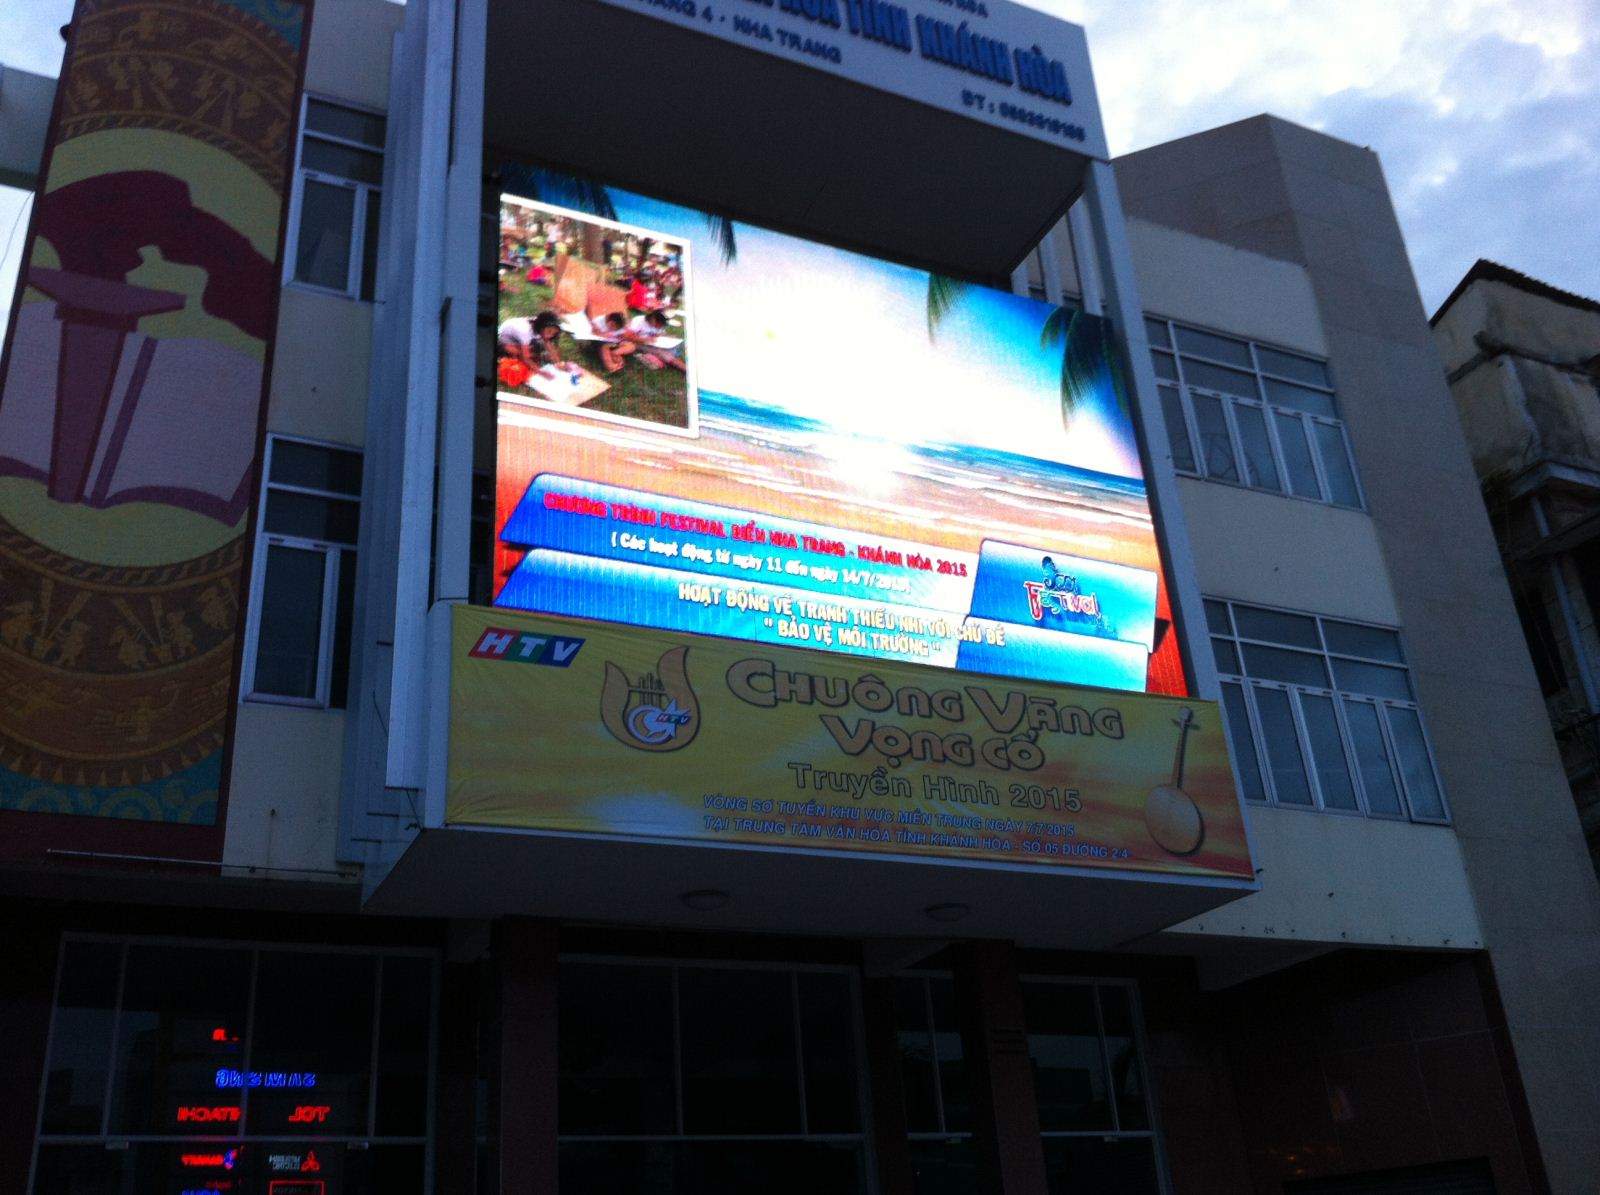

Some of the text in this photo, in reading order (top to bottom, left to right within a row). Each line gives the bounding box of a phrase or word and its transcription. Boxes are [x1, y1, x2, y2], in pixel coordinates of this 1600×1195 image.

[733, 14, 774, 42] NHA
[776, 28, 842, 64] TRANG
[660, 511, 726, 538] FESTIVAL
[769, 529, 798, 549] NHA
[802, 535, 846, 558] TRANG
[858, 545, 903, 567] KHÁNH
[906, 551, 933, 572] HÒA
[936, 558, 968, 578] 2015
[767, 557, 783, 572] 11
[679, 583, 721, 607] HOẠT
[726, 586, 770, 613] ĐỘNG
[798, 599, 847, 623] TRANH
[850, 607, 896, 631] THIẾU
[900, 615, 924, 635] NHI
[924, 617, 951, 639] VỚI
[955, 623, 982, 643] CHỦ
[476, 631, 582, 663] HTV
[777, 614, 810, 640] BẢO
[813, 622, 833, 646] VỆ
[838, 625, 867, 649] MÔI
[870, 632, 929, 657] TRƯỜNG
[657, 712, 690, 725] HTV
[787, 762, 1083, 813] Truyền Hình 2015
[704, 815, 730, 833] TẠI
[734, 817, 786, 835] TRUNG
[790, 822, 823, 837] TÂM
[896, 828, 926, 844] TỈNH
[930, 833, 979, 848] KHÁNH
[1045, 843, 1059, 855] 05
[830, 806, 861, 820] KHU
[936, 815, 982, 830] TRUNG
[985, 816, 1024, 833] NGÀY
